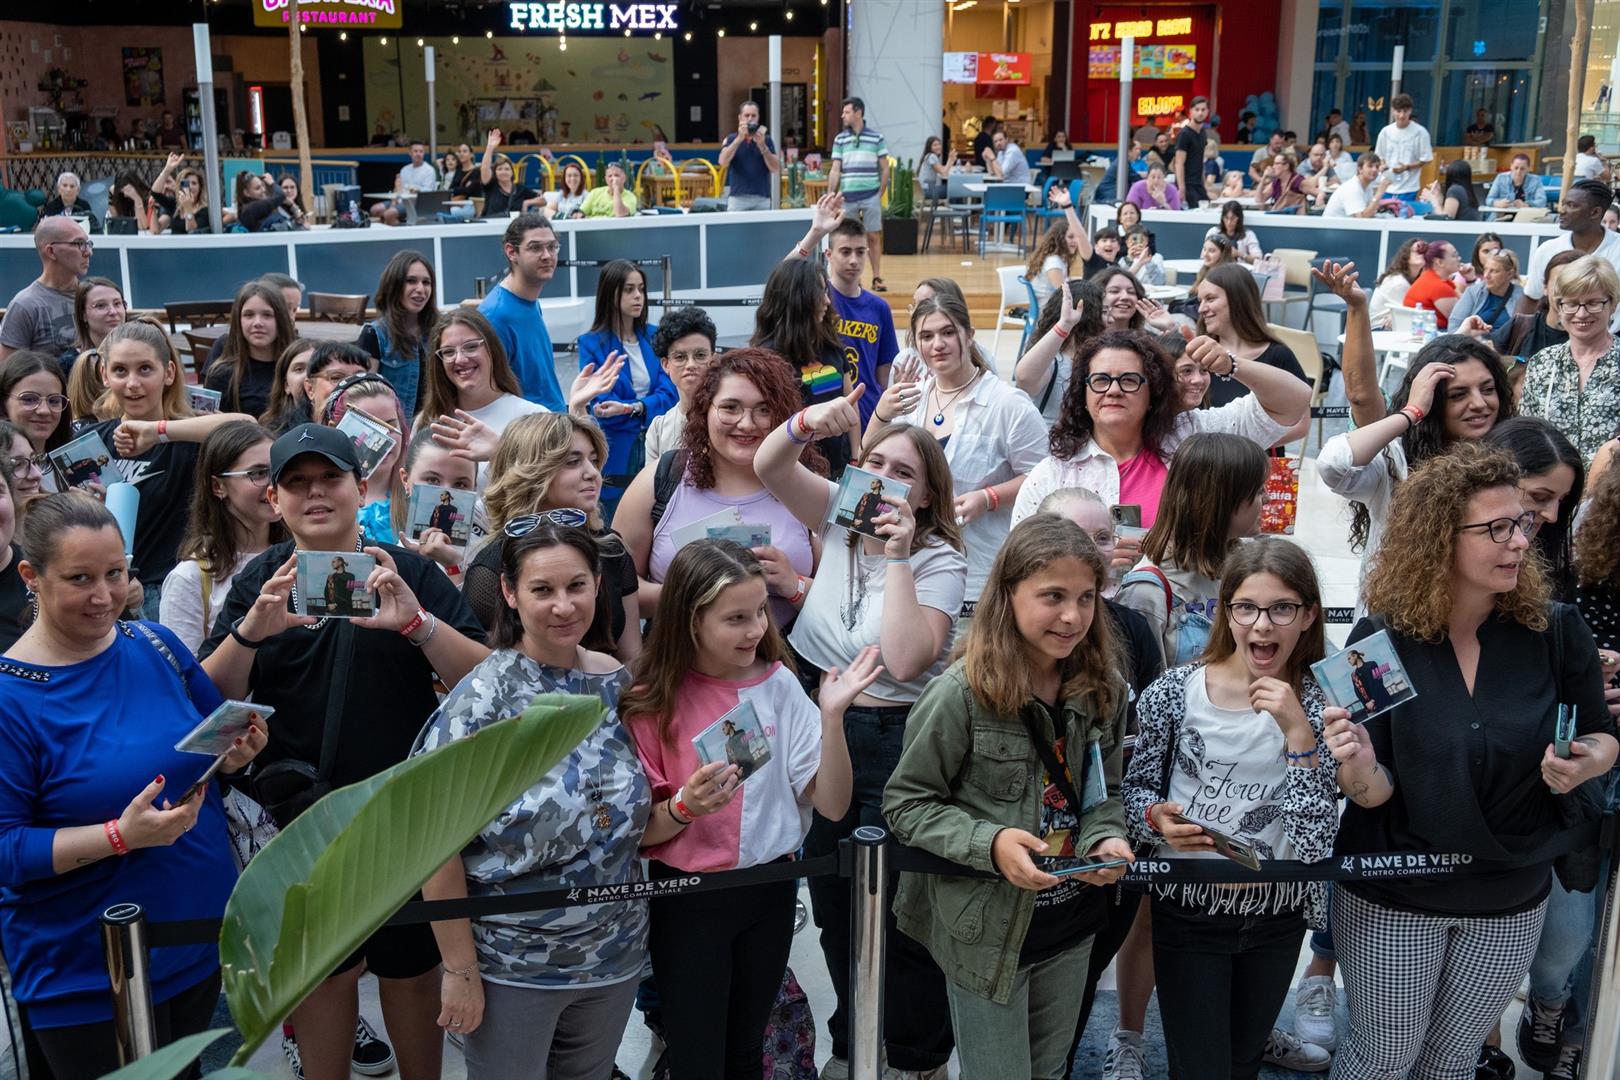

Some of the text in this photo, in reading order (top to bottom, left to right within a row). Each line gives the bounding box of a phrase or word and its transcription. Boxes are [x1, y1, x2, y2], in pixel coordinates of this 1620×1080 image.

[509, 3, 678, 29] FRESH MEX
[834, 318, 879, 343] AKERS
[1128, 861, 1171, 874] VERO
[1360, 853, 1473, 869] NAVE DE VERO
[1117, 873, 1152, 882] ERCIALE
[1361, 866, 1455, 877] CENTRO COMMERCIALE
[587, 876, 701, 898] NAVE DE VERO
[587, 887, 681, 903] CENTRO COMMERCIALE
